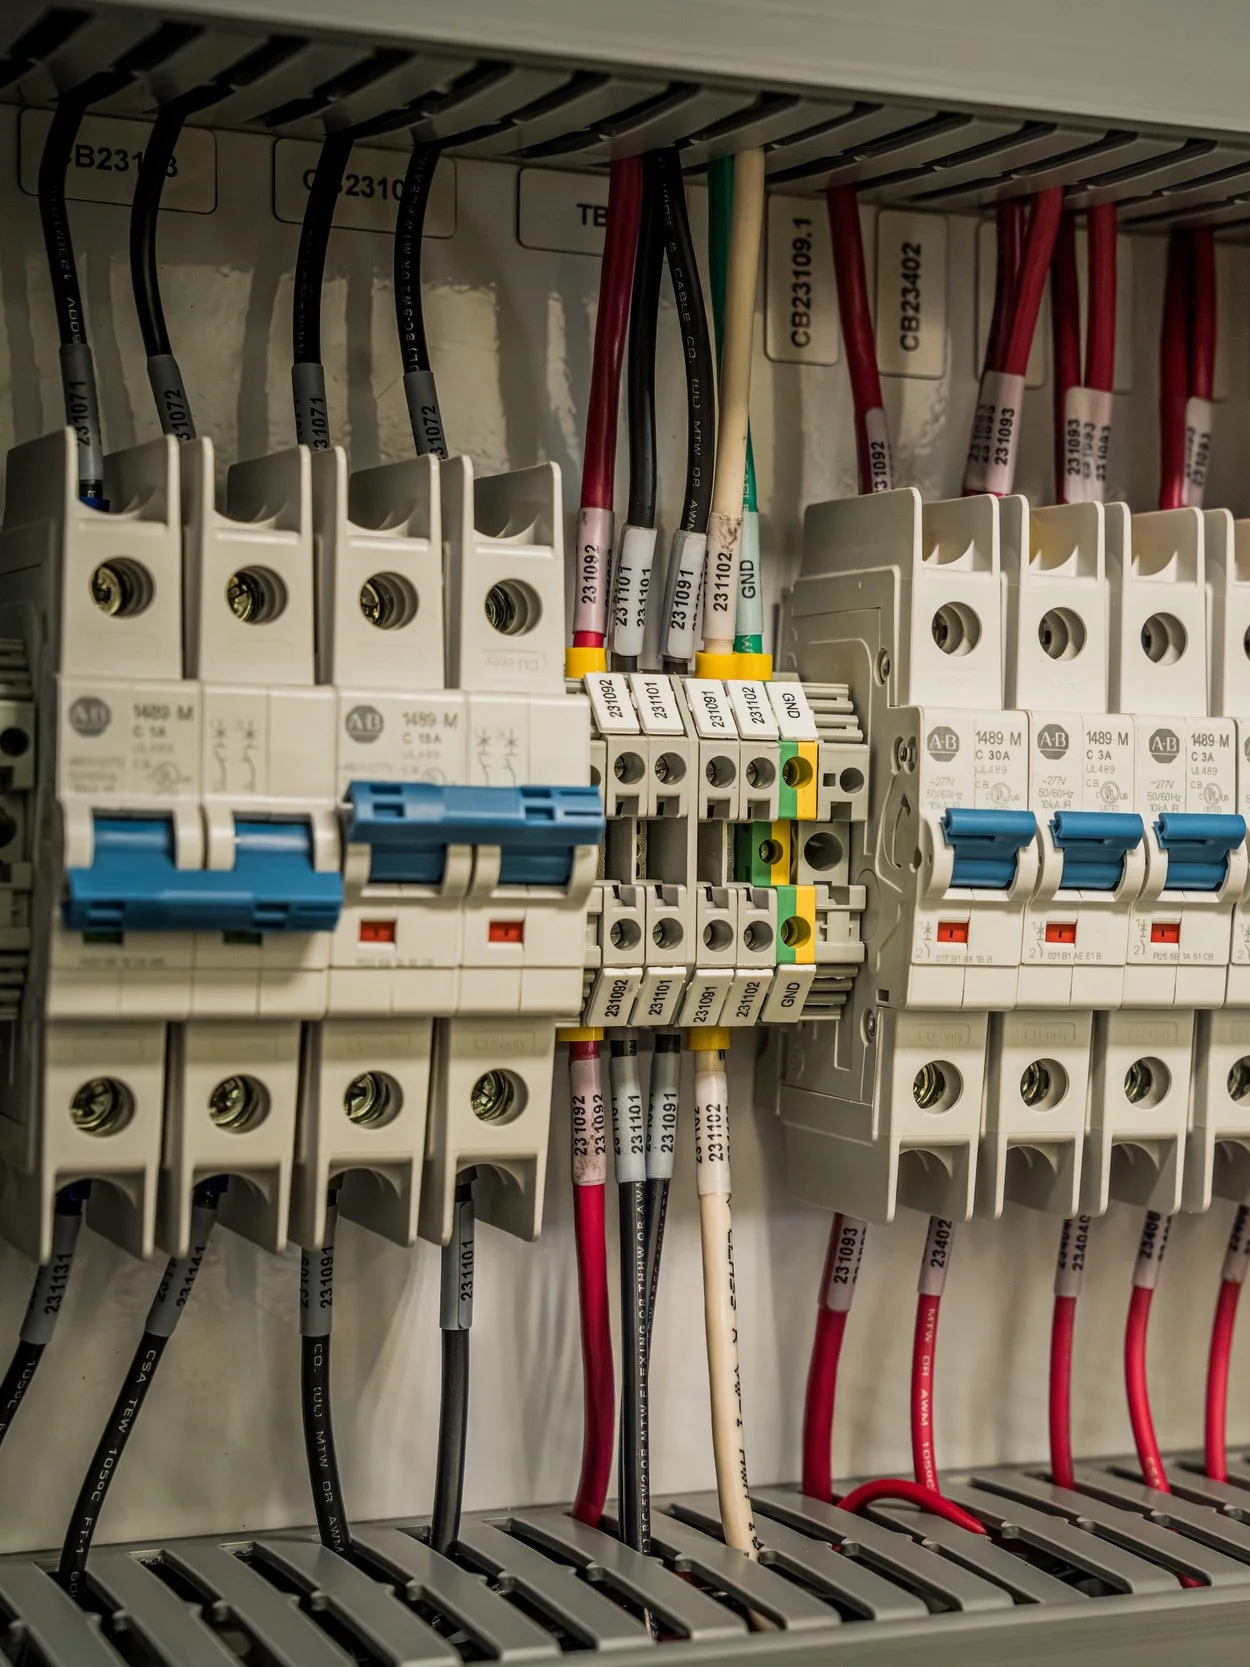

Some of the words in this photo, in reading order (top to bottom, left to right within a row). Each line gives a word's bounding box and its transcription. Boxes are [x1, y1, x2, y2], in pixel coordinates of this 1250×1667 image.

[674, 267, 691, 323] CABLE
[790, 217, 813, 348] CB23109.1
[900, 242, 921, 352] CB23402
[693, 420, 702, 455] MTW
[994, 407, 1016, 466] 231093
[1066, 418, 1082, 476] 231093
[692, 466, 701, 488] OR
[581, 544, 601, 605] 231092
[713, 551, 733, 613] 231102
[739, 559, 756, 600] GND
[614, 565, 633, 628] 231101
[670, 569, 695, 631] 231091
[599, 678, 624, 719] 231092
[646, 680, 669, 720] 231101
[700, 690, 726, 729] 231091
[742, 686, 766, 725] 231102
[782, 692, 801, 719] GND
[402, 733, 412, 745] C
[975, 750, 983, 761] C
[988, 751, 1011, 761] 30A
[1086, 750, 1094, 761] C
[1098, 751, 1112, 761] 3A
[1191, 751, 1198, 762] C
[1201, 752, 1214, 763] 3A
[604, 978, 629, 1018] 231092
[648, 979, 673, 1016] 231101
[693, 985, 718, 1024] 231091
[736, 981, 761, 1018] 231102
[781, 982, 801, 1008] GND
[573, 1094, 588, 1157] 231092
[628, 1094, 645, 1155] 231101
[660, 1092, 677, 1154] 231091
[706, 1102, 724, 1163] 231102
[637, 1222, 646, 1242] OR
[929, 1219, 953, 1269] 23402
[460, 1239, 476, 1302] 231101
[637, 1248, 646, 1295] THHW
[833, 1226, 858, 1285] 231093
[44, 1253, 73, 1316] 231131
[924, 1307, 936, 1343] MTW
[135, 1349, 157, 1385] CSA
[921, 1355, 931, 1377] OR
[117, 1397, 141, 1433] TEW
[312, 1386, 324, 1419] (UL)
[920, 1388, 930, 1427] AWM
[640, 1404, 649, 1443] MTW
[316, 1429, 329, 1469] MTW
[640, 1448, 649, 1470] OR
[322, 1479, 334, 1503] OR
